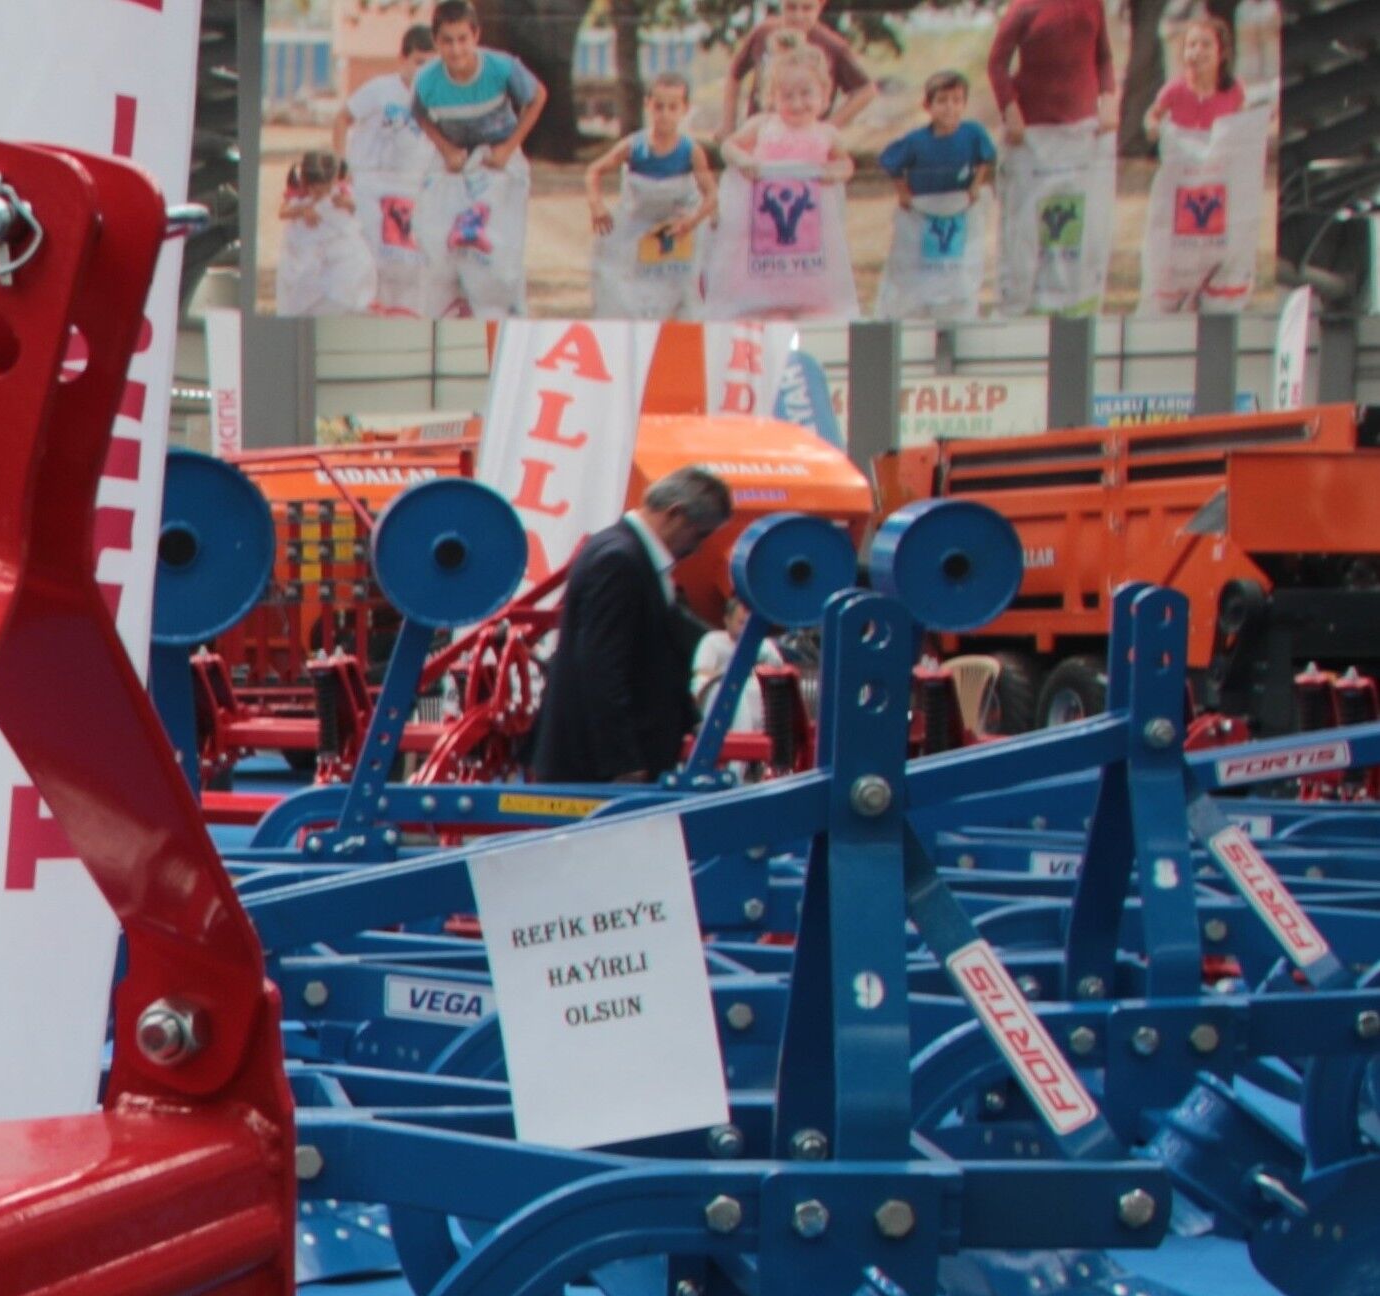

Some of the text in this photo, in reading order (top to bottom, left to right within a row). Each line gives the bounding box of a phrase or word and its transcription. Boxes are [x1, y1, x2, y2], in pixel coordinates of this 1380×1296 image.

[511, 915, 587, 948] REFİK
[409, 986, 483, 1016] VEGA
[564, 996, 644, 1026] OLSUN
